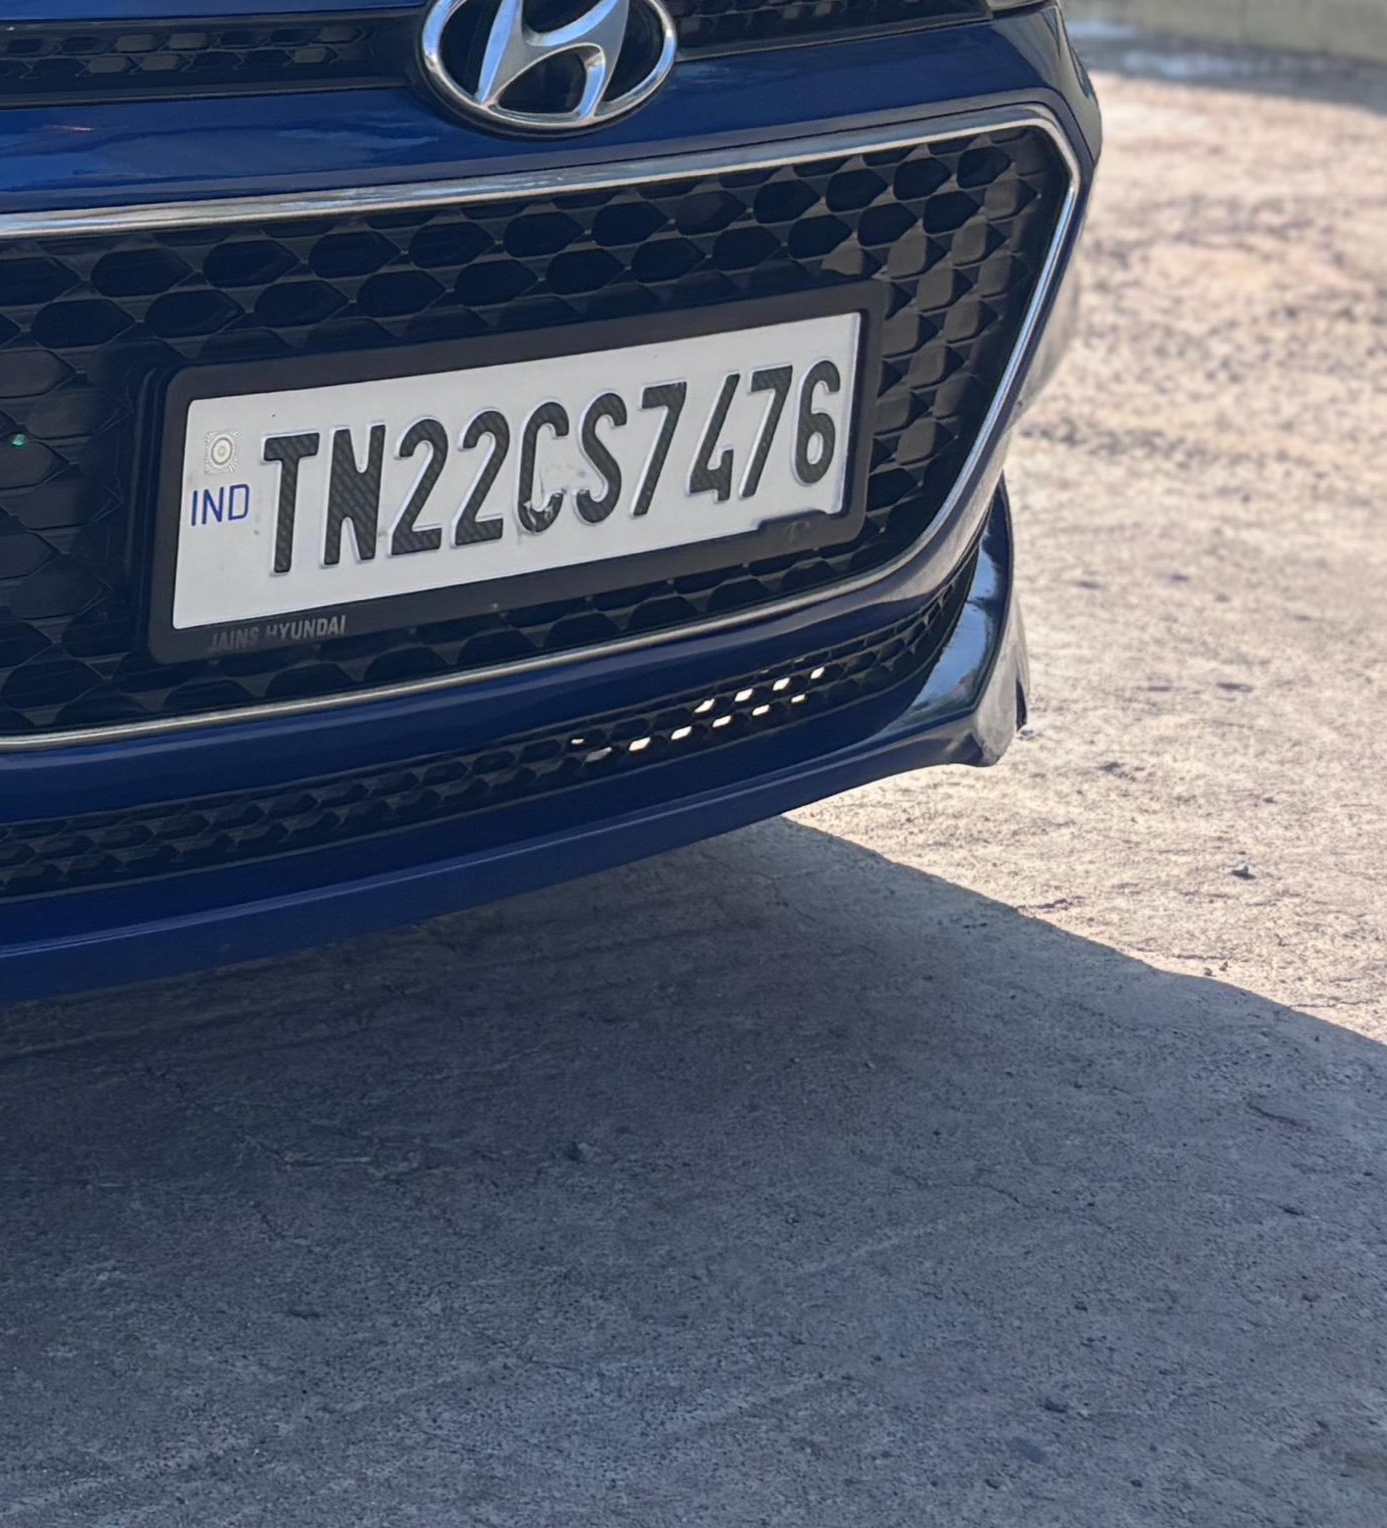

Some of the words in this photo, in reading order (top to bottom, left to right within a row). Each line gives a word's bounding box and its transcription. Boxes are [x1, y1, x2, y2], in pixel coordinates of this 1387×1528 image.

[263, 359, 841, 574] TN22CS7476
[190, 483, 250, 526] IND
[266, 615, 347, 641] HYUNDAI
